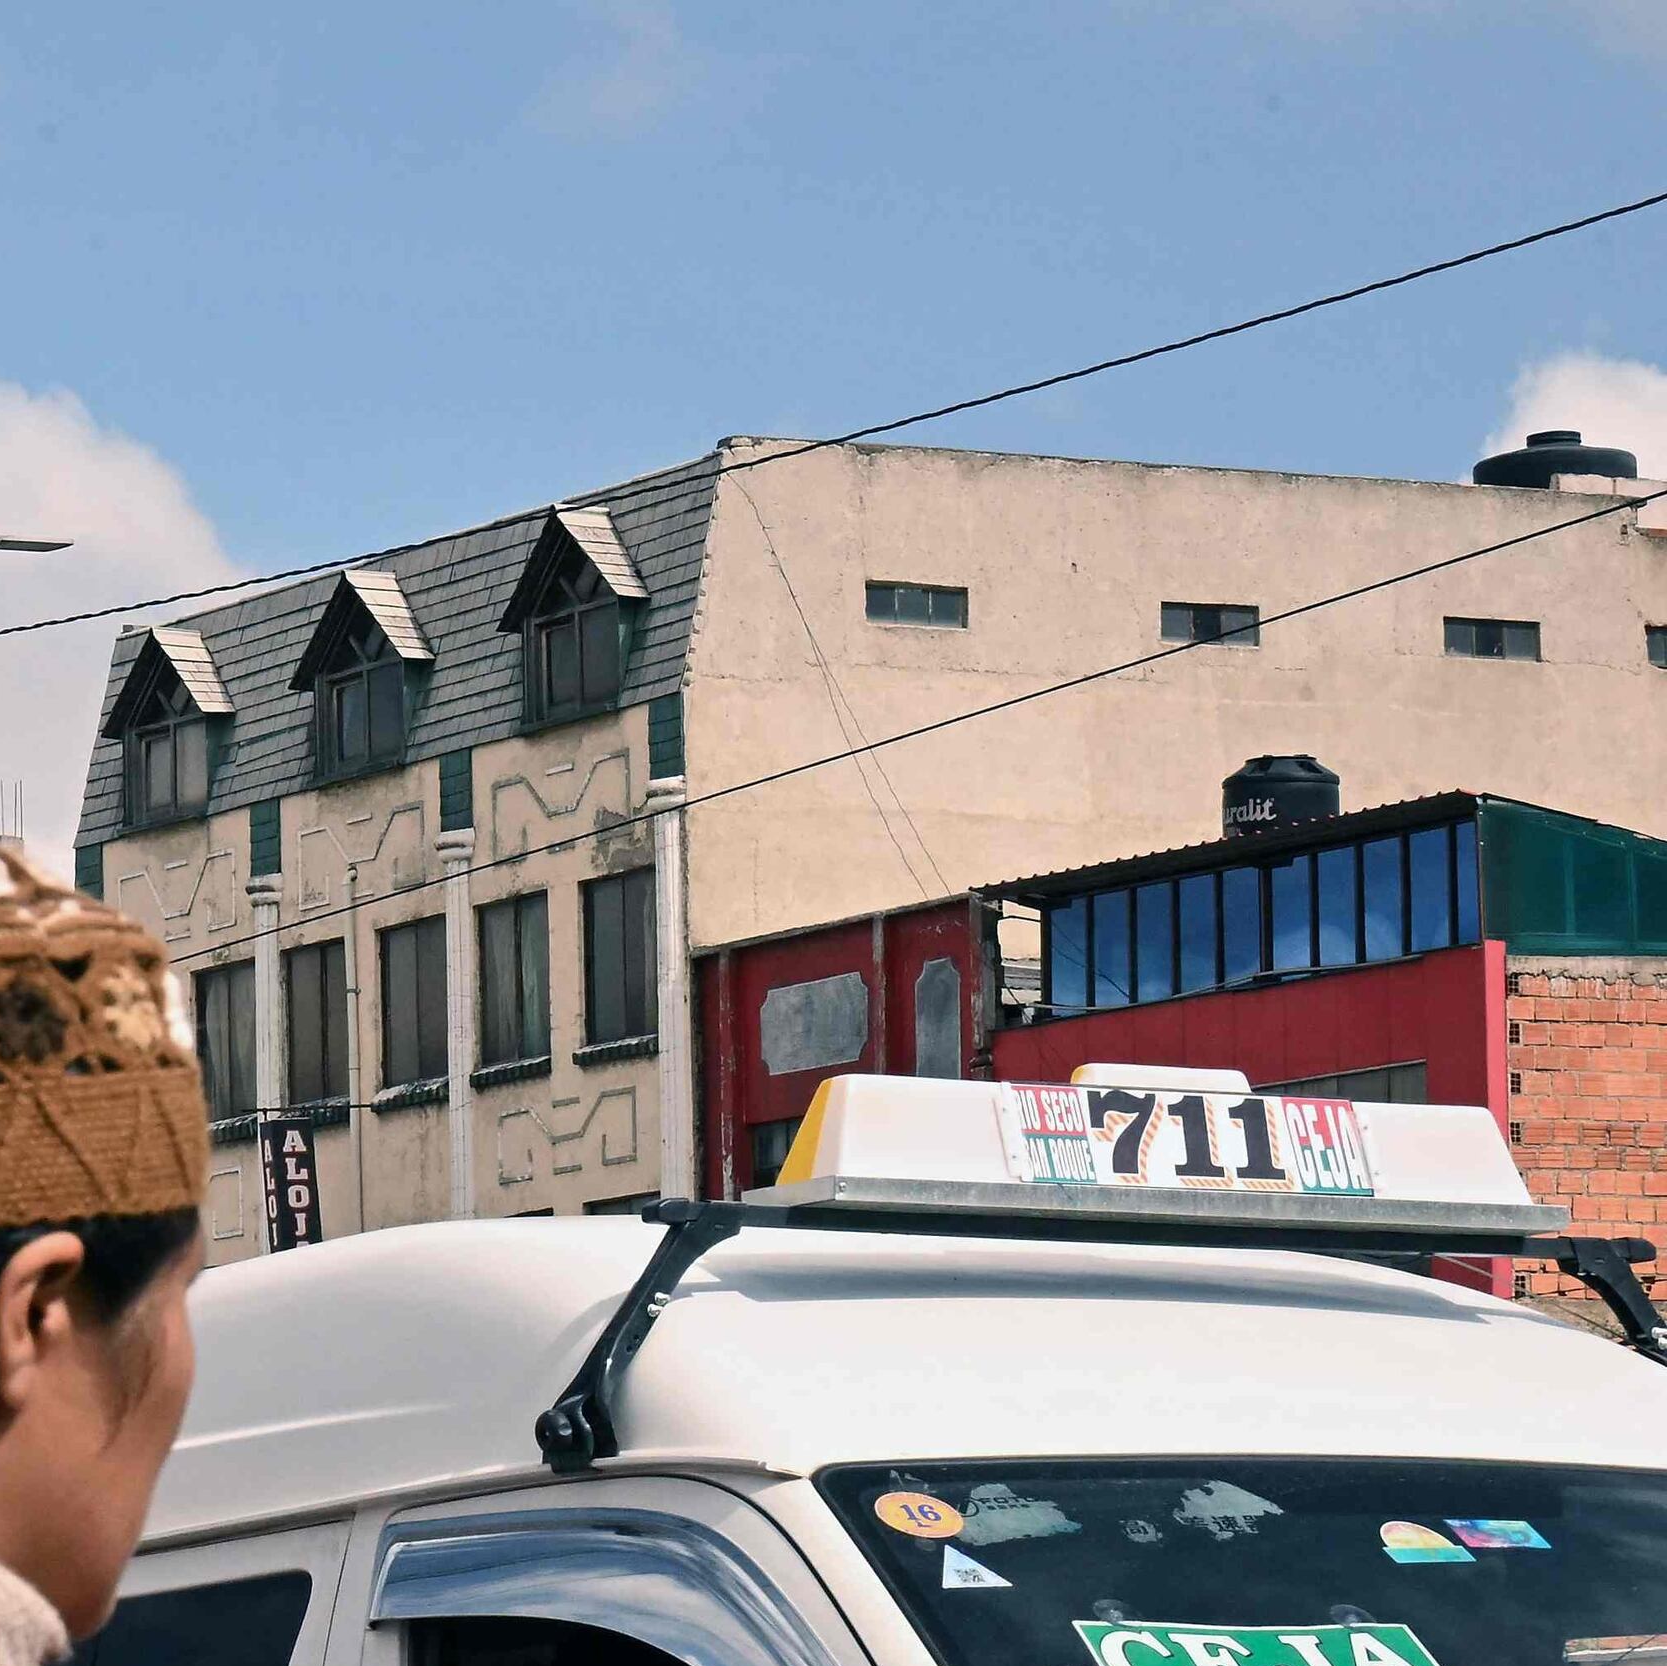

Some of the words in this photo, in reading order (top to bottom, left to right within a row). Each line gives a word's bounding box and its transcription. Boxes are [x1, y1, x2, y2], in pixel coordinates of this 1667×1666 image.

[1223, 798, 1277, 825] uralit
[1040, 1090, 1084, 1133] SECO
[1087, 1089, 1286, 1181] 711
[1287, 1102, 1367, 1190] CEJA
[282, 1130, 310, 1248] ALOJ
